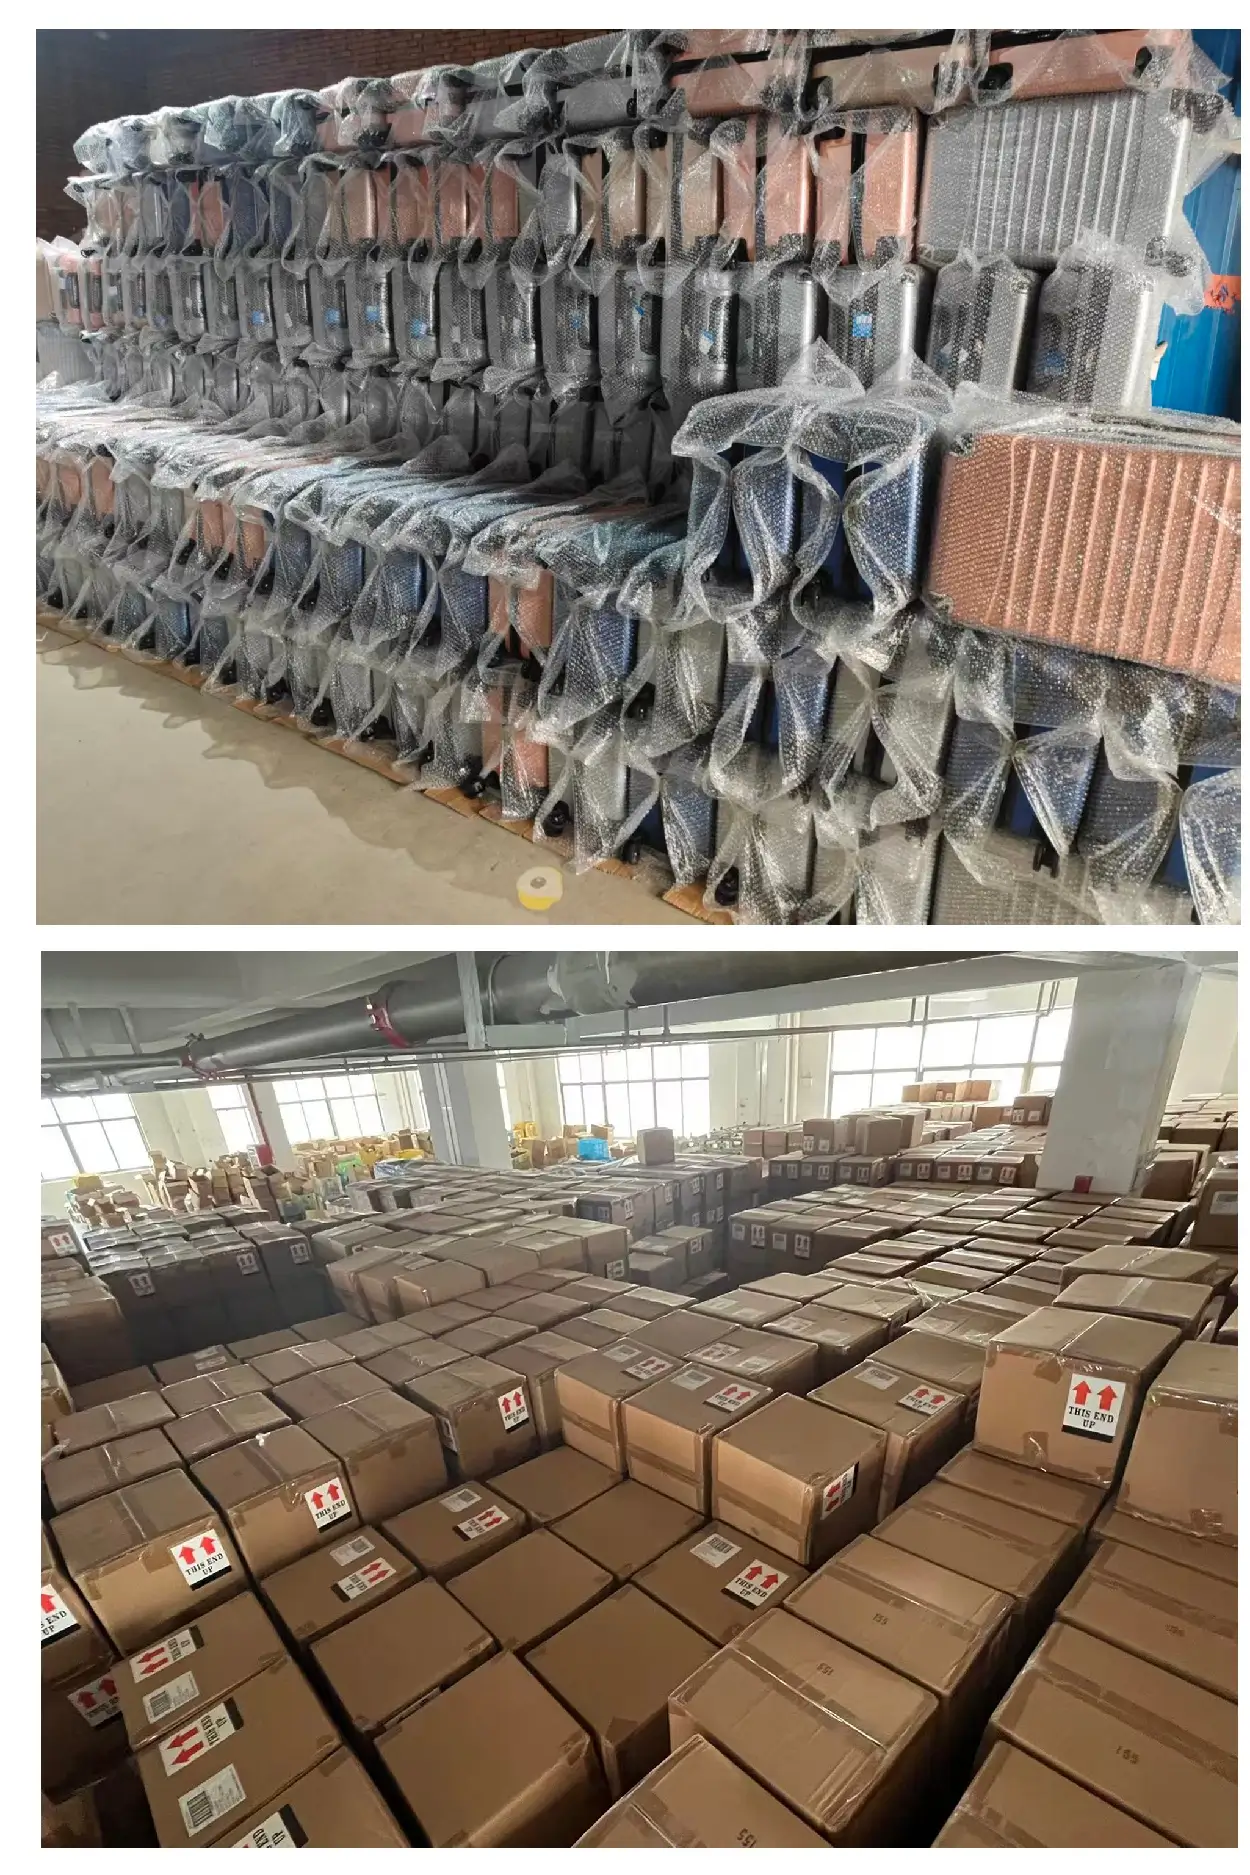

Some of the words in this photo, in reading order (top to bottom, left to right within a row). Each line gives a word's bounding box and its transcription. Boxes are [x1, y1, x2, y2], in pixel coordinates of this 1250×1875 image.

[1069, 1406, 1090, 1419] THIS
[1094, 1411, 1114, 1424] END
[1083, 1419, 1096, 1429] UP
[315, 1508, 331, 1520] THIS
[331, 1500, 346, 1512] END
[327, 1512, 337, 1520] UP
[186, 1563, 205, 1576] THIS
[206, 1552, 224, 1567] END
[202, 1565, 213, 1575] UP
[735, 1578, 752, 1590] THIS
[752, 1586, 769, 1598] END
[46, 1610, 67, 1625] END
[42, 1625, 55, 1636] UP
[272, 1830, 286, 1846] UP
